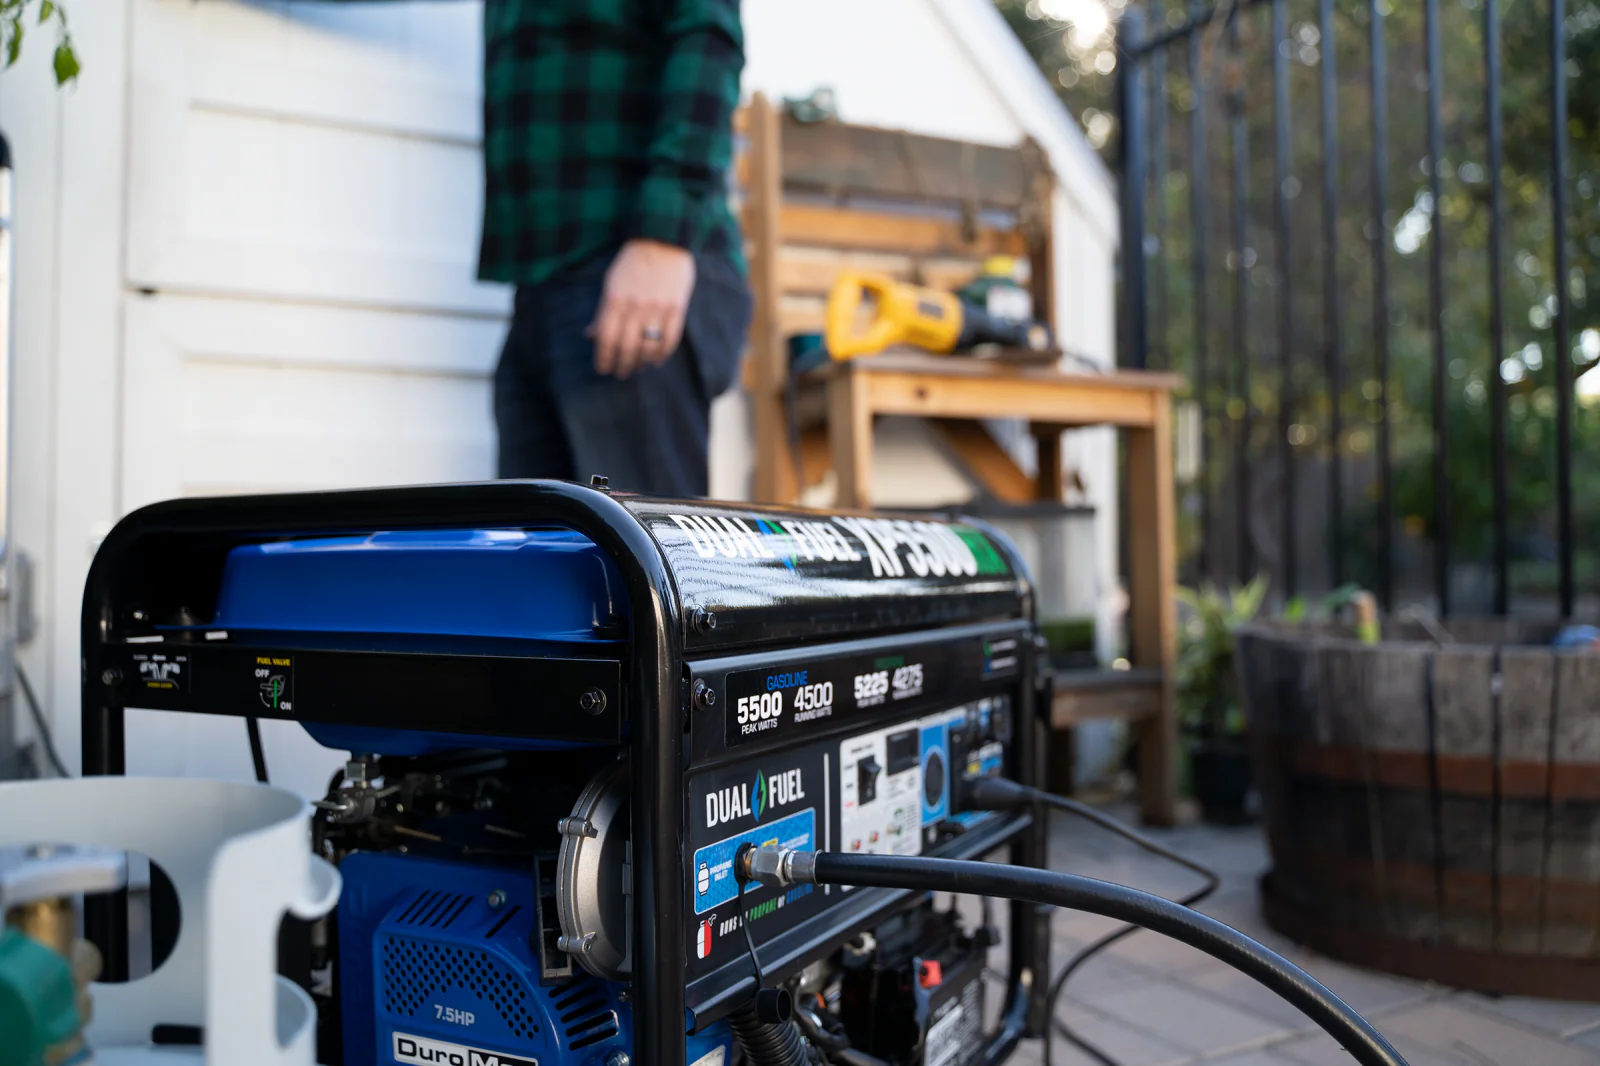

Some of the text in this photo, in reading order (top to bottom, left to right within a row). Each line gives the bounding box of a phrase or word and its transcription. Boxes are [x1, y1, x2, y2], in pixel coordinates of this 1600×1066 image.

[668, 515, 775, 558] DUAL
[780, 520, 862, 561] FUEL
[256, 656, 291, 666] FUEL VALVE
[255, 668, 270, 678] OFF
[766, 670, 808, 690] GASOLINE
[854, 670, 888, 700] 5225
[892, 663, 923, 690] 4275
[280, 701, 292, 710] ON
[737, 691, 782, 724] 5500
[793, 681, 833, 711] 4500
[741, 718, 778, 735] PEAK WATTS
[706, 768, 805, 828] DUAL FUEL
[710, 860, 732, 874] PROPANE
[434, 1004, 475, 1026] 7.5HP
[398, 1038, 514, 1066] DuroM
